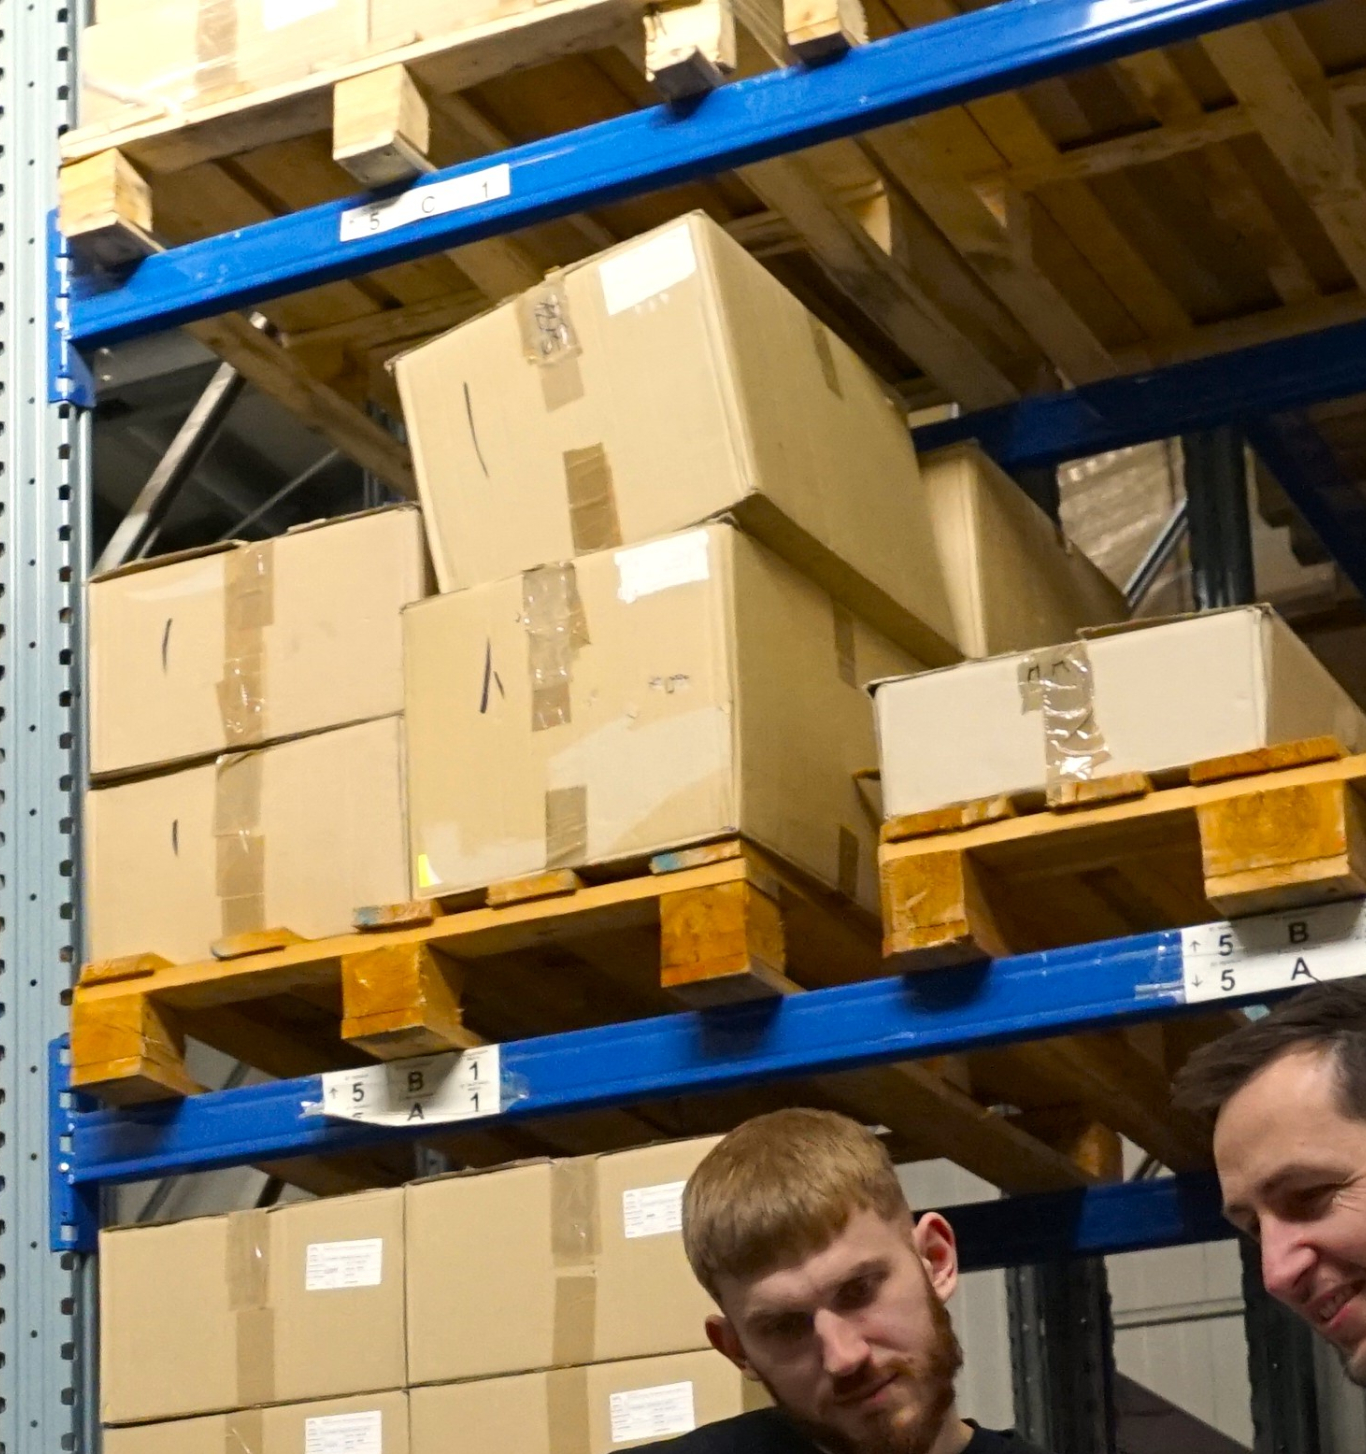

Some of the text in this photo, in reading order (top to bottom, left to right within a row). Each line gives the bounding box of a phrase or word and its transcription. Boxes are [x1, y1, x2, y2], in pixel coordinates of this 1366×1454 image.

[369, 181, 489, 231] 5 C 1
[1218, 934, 1234, 957] 5
[1288, 921, 1310, 944] B
[1220, 969, 1236, 992] 5
[1290, 957, 1312, 981] A
[352, 1060, 479, 1103] 5 B 1
[406, 1092, 480, 1122] A 1
